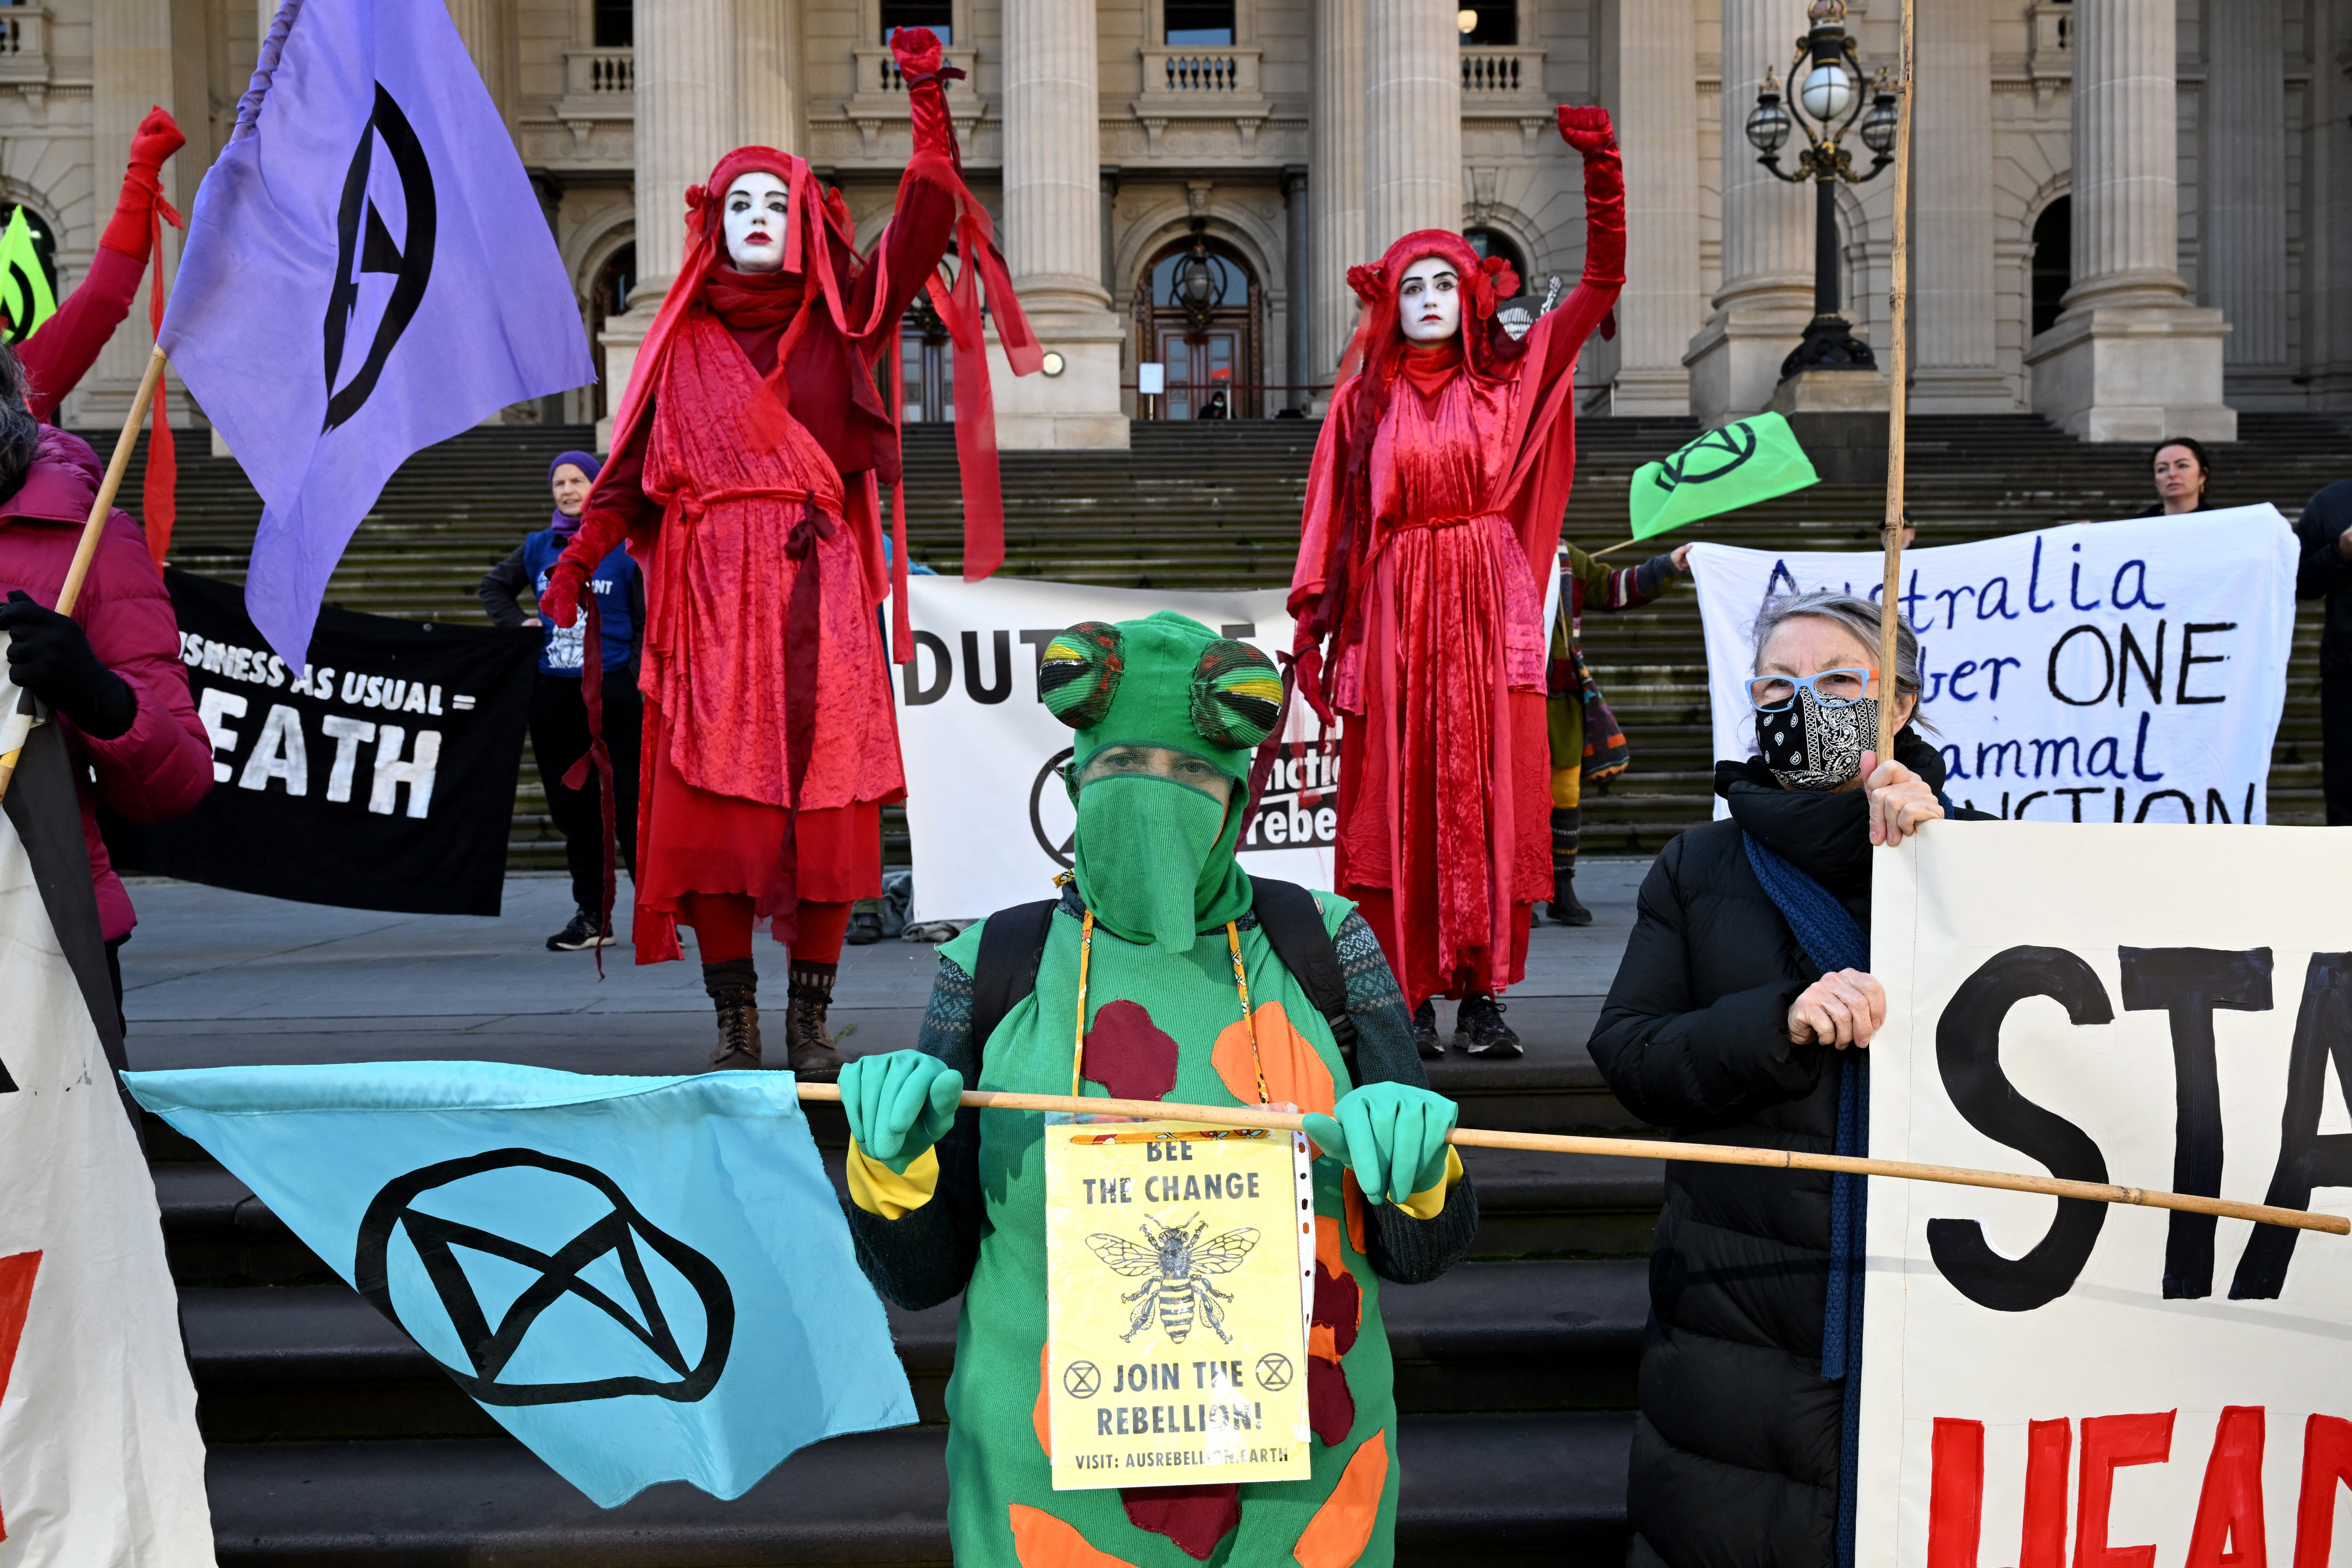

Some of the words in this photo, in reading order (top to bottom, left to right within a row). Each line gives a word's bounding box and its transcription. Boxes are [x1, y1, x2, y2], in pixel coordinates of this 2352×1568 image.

[2048, 619, 2237, 707] ONE
[290, 664, 335, 700] AS
[341, 672, 443, 715] USUAL
[199, 687, 442, 819] EATH
[1943, 711, 2164, 782] ammal
[1147, 1141, 1193, 1162] BEE
[1083, 1178, 1132, 1204] THE
[1145, 1172, 1259, 1202] CHANGE
[1114, 1363, 1179, 1393] JOIN
[1193, 1361, 1243, 1389] THE
[1097, 1402, 1262, 1435] REBELLION!
[1075, 1454, 1119, 1470] VISIT:
